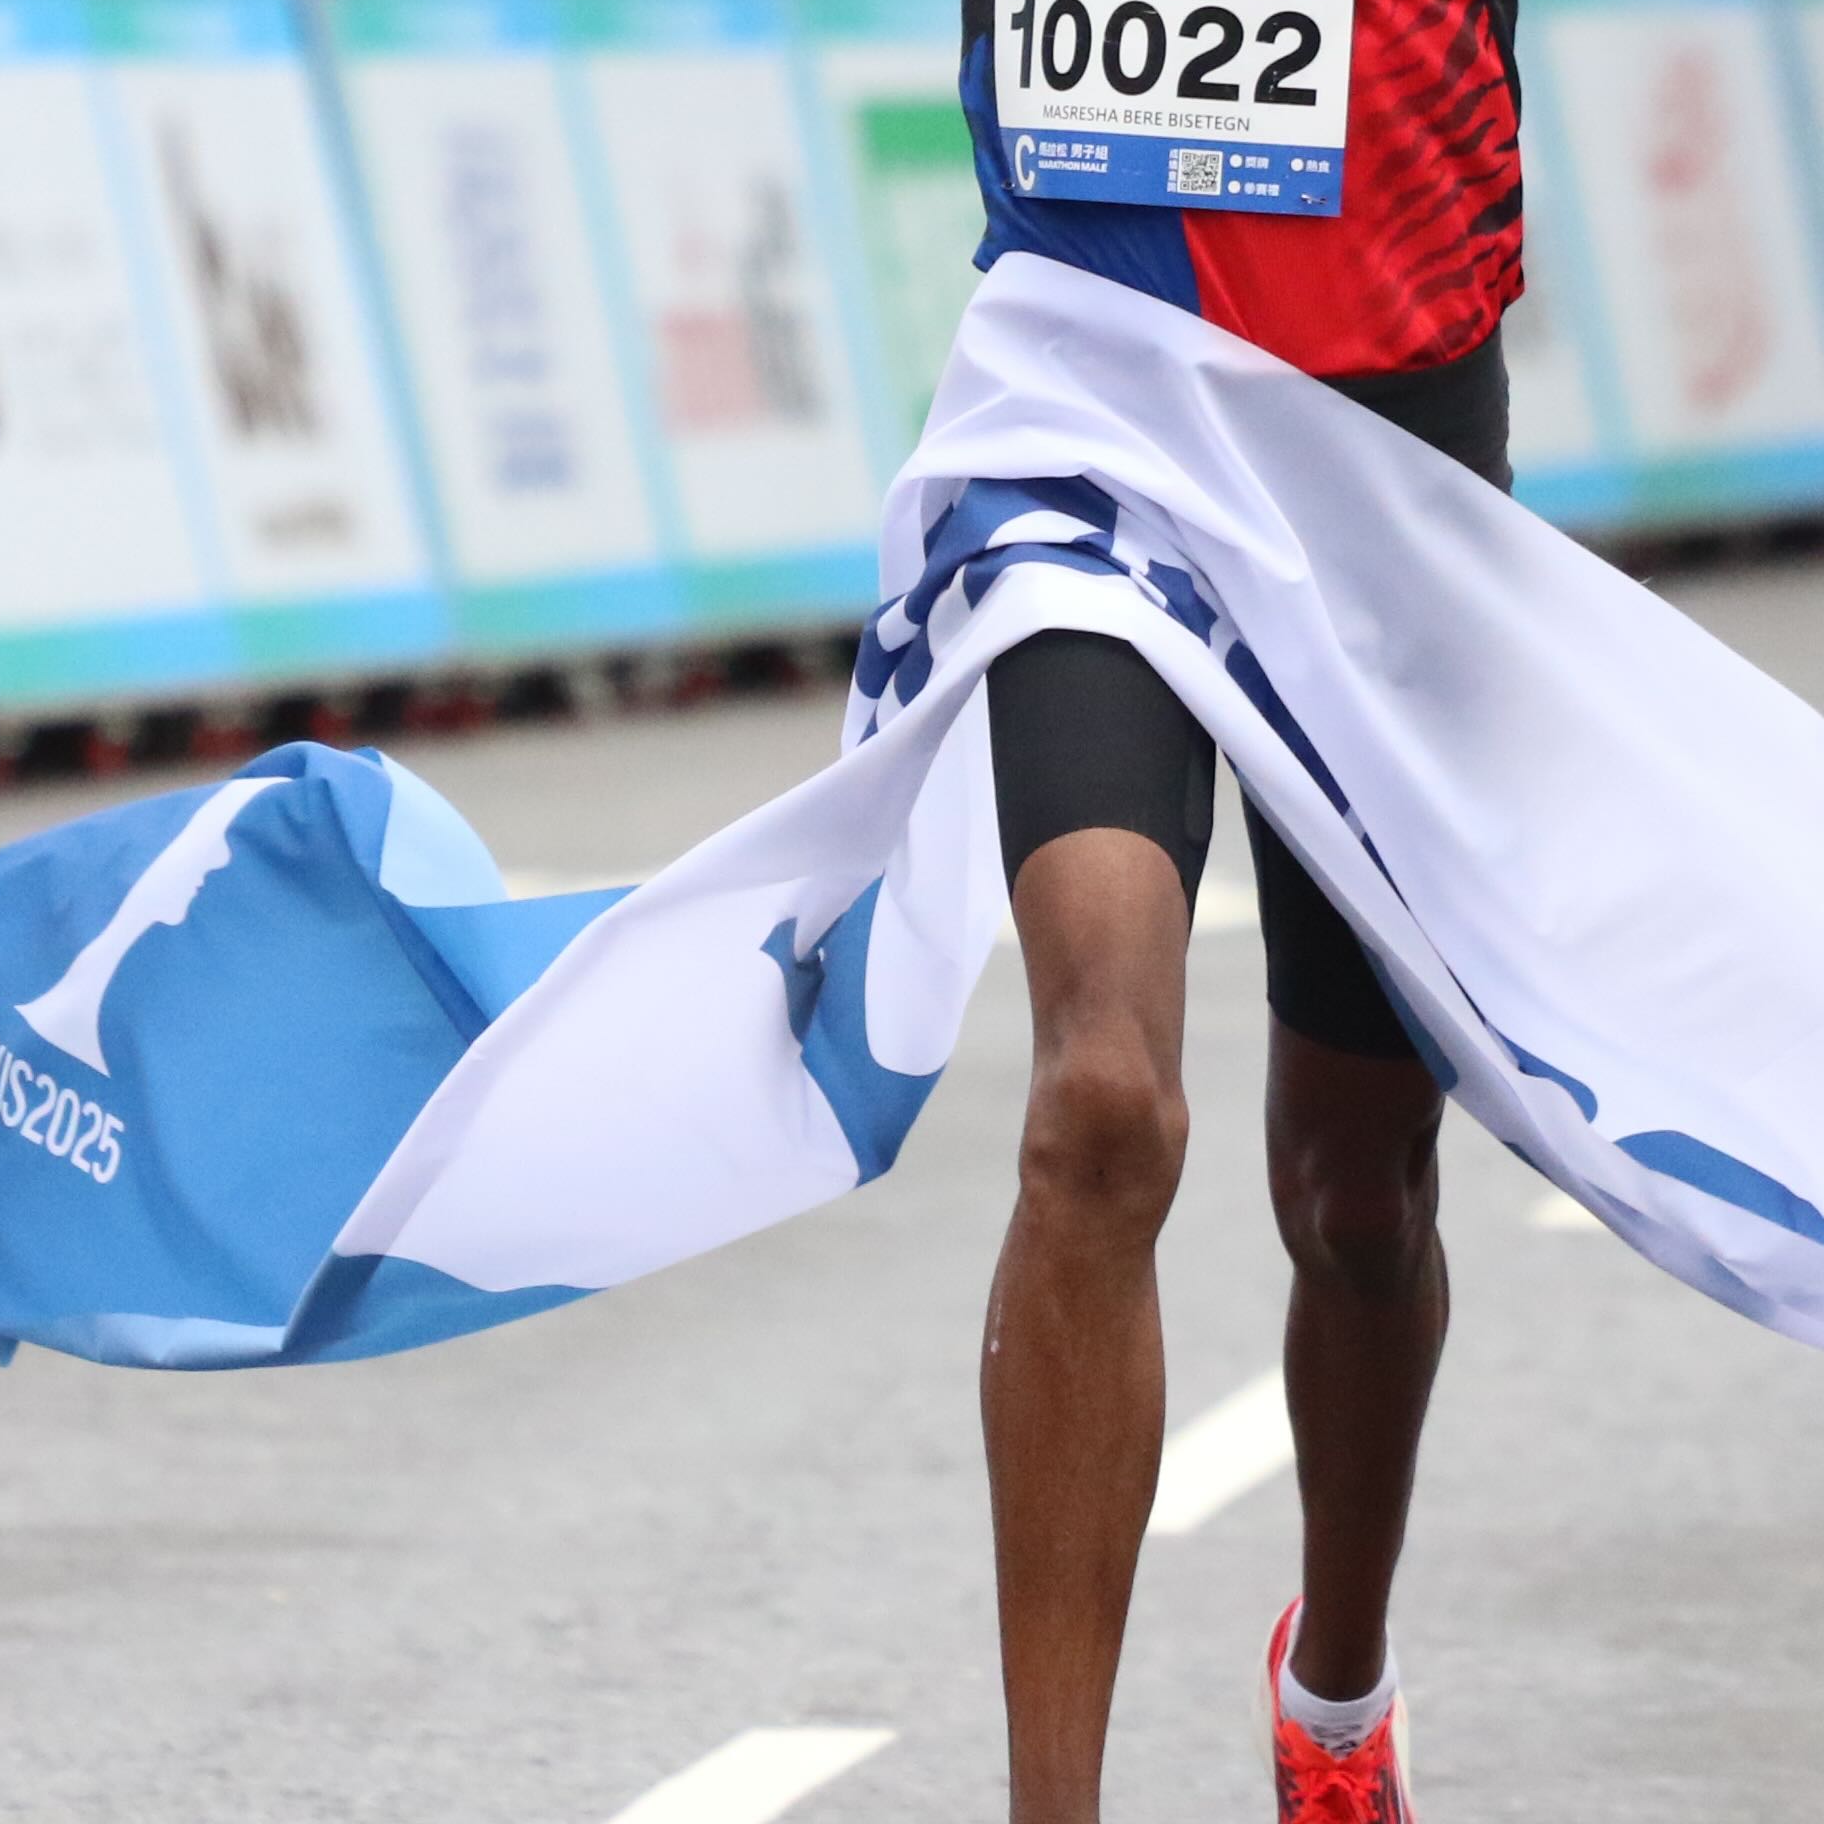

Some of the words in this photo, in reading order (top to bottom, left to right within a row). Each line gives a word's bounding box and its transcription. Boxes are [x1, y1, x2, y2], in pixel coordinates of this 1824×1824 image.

[1042, 104, 1118, 123] MASRESHA
[1123, 109, 1163, 126] BERE
[1168, 112, 1251, 132] BISETEGN
[1014, 134, 1036, 191] C
[1070, 142, 1109, 160] 男子組
[1080, 162, 1108, 173] MALE
